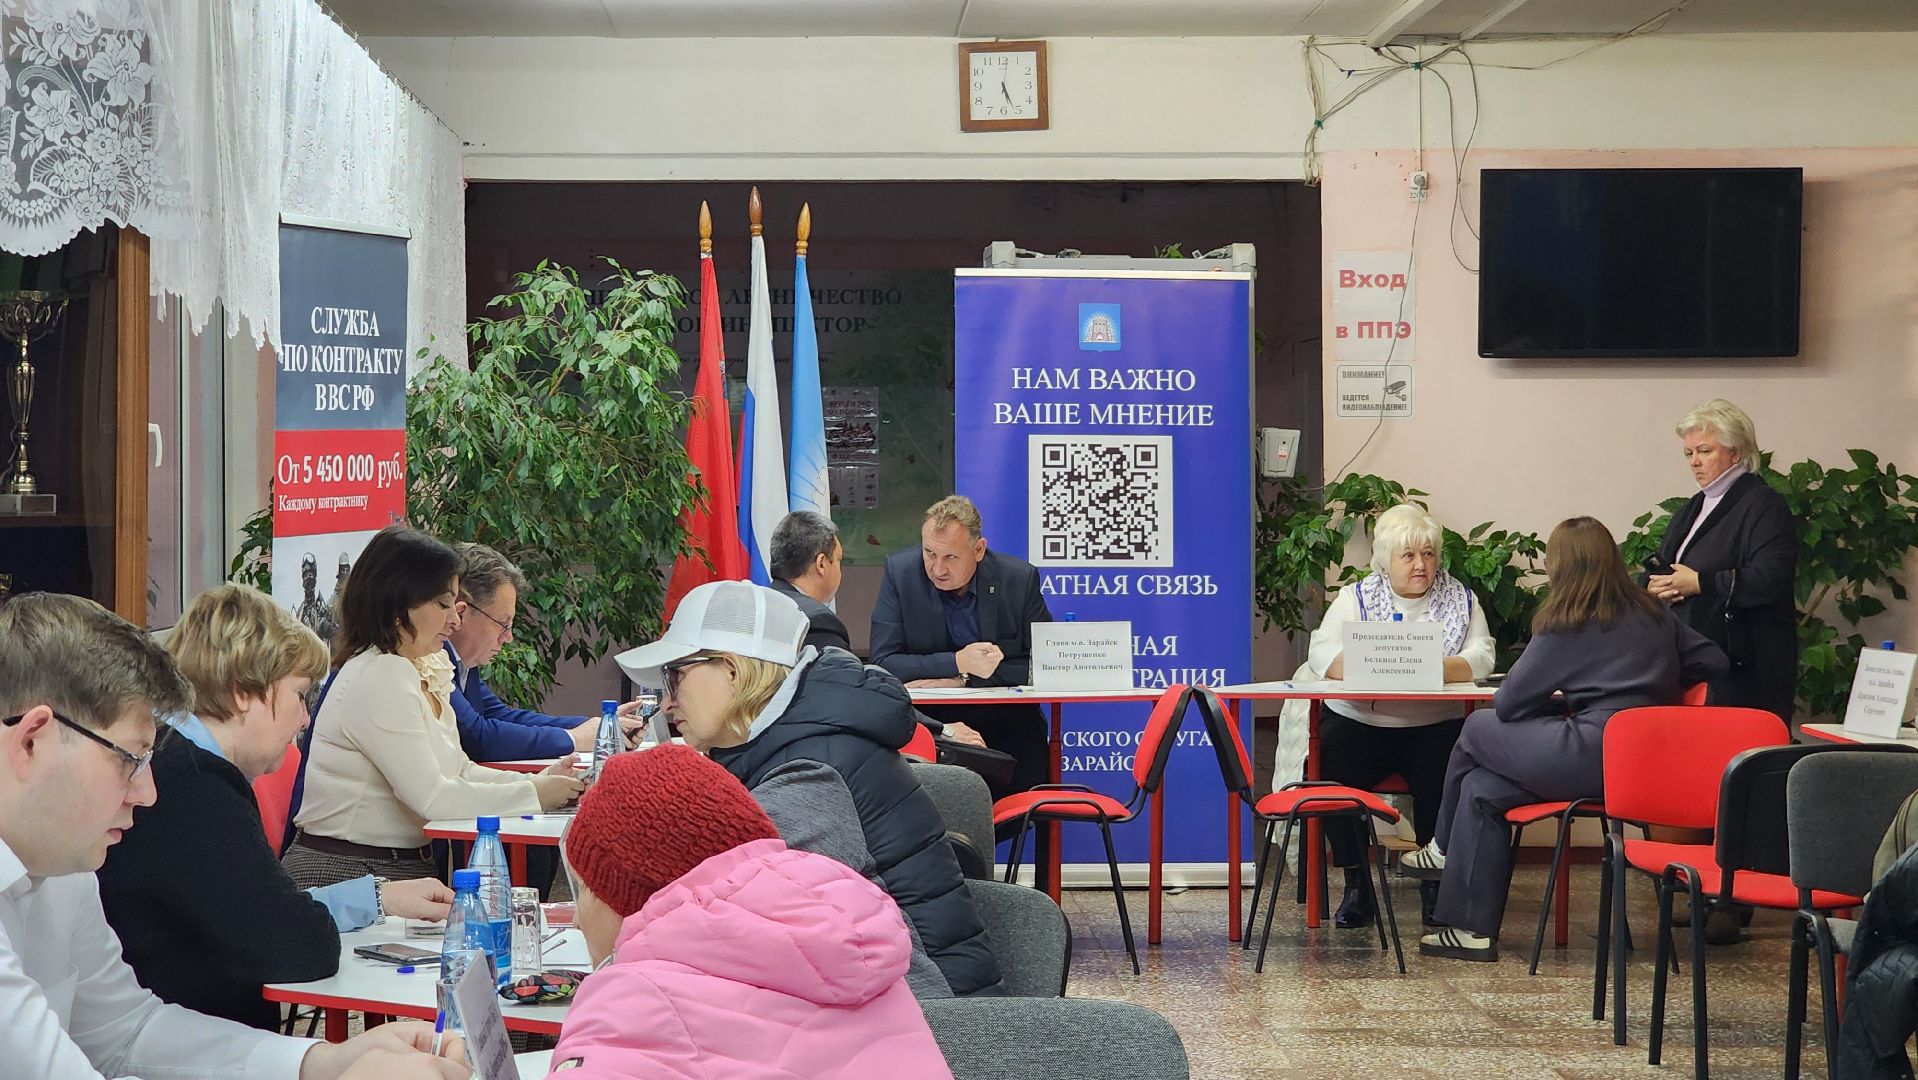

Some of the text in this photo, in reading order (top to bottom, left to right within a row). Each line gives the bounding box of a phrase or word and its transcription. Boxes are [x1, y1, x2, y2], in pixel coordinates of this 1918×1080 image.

[983, 56, 992, 66] 11
[997, 56, 1008, 66] 12
[973, 68, 984, 77] 10
[1024, 67, 1031, 76] 2
[974, 81, 983, 91] 9
[1024, 81, 1033, 90] 3
[974, 96, 983, 106] 8
[1024, 95, 1033, 105] 4
[985, 106, 994, 116] 7
[1000, 106, 1008, 116] 6
[1014, 105, 1022, 115] 5
[1339, 269, 1407, 291] Вход
[310, 306, 380, 337] СЛУЖБА
[1336, 321, 1411, 339] в ППЭ
[282, 343, 403, 375] ПО КОНТРАКТУ
[1011, 367, 1196, 391] НАМ ВАЖНО
[1342, 370, 1385, 379] ВНИМАНИЕ!
[1342, 394, 1370, 403] ВЕДЕТСЯ
[993, 402, 1214, 426] ВАШЕ МНЕНИЕ
[278, 451, 403, 489] От 5 450 000 руб.
[278, 495, 368, 515] Каждому контрактнику
[1040, 574, 1218, 595] АТНАЯ СВЯЗЬ
[1352, 632, 1434, 641] Председатель Совета
[1087, 638, 1118, 647] Зарайск
[1058, 651, 1107, 660] Петрушенко
[1399, 656, 1422, 664] Елена
[1042, 663, 1123, 672] Виктор Анатольевич
[1370, 667, 1416, 675] Алексеевна
[1061, 731, 1131, 747] СКОГО
[1060, 751, 1135, 772] ЗАРАЙС
